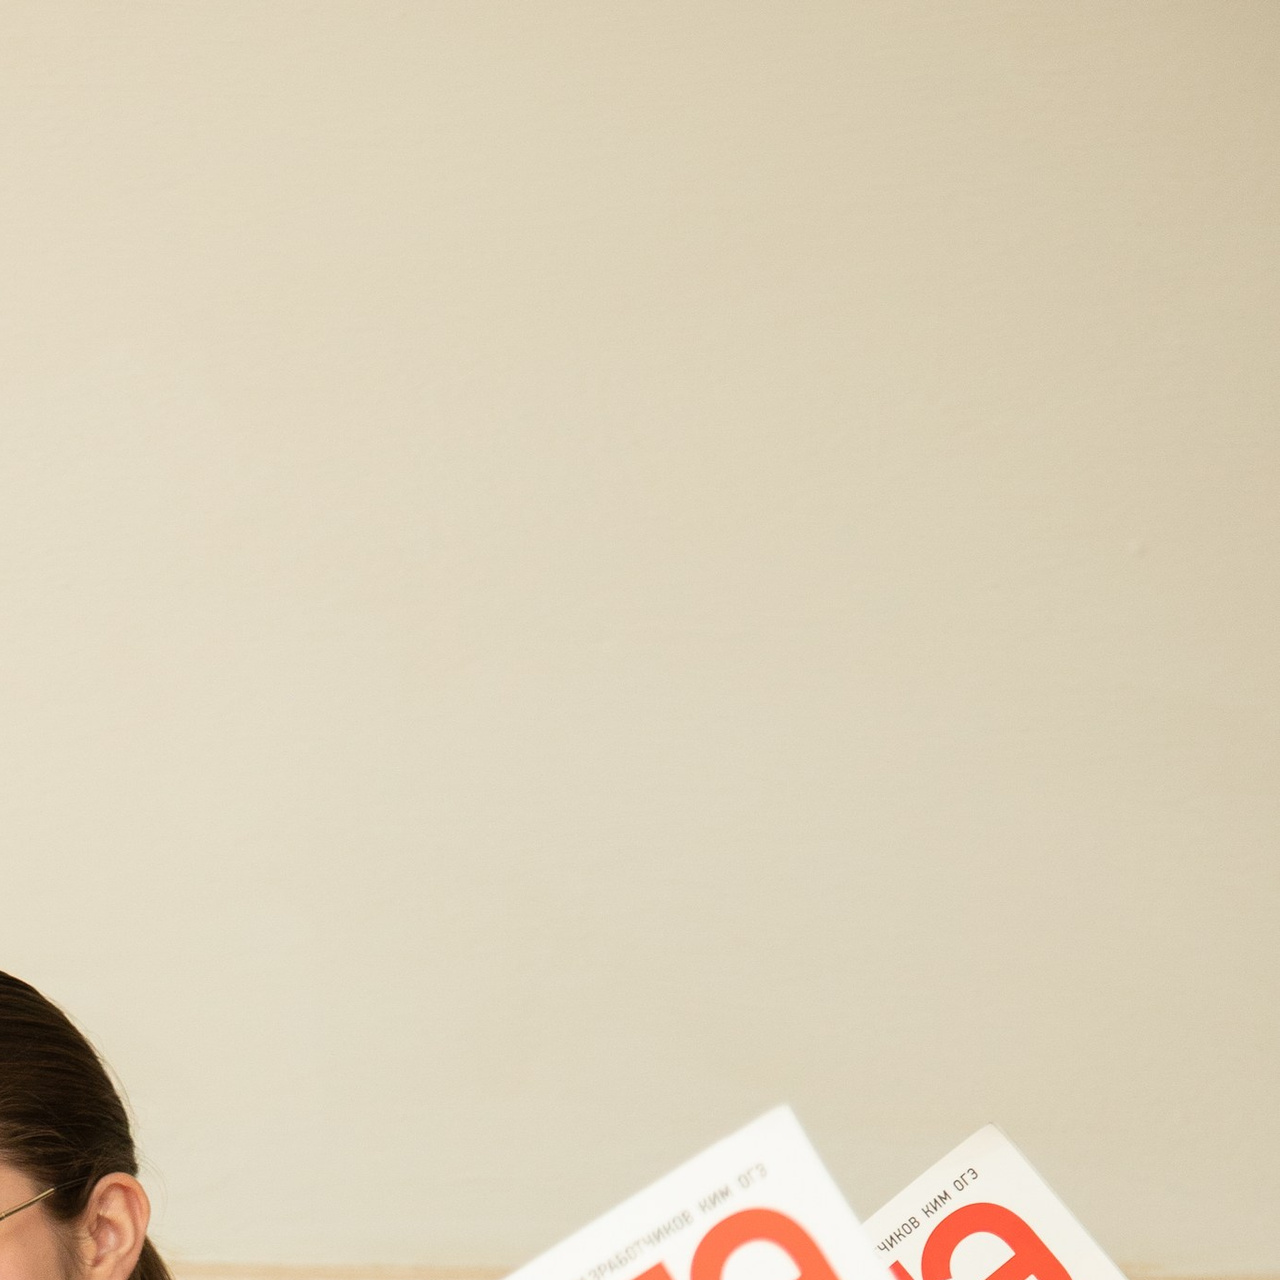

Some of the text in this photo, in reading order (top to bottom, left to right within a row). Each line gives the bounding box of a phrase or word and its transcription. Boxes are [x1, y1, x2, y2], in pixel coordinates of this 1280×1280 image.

[875, 1167, 979, 1252] ЧИКОВ КИМ ОГЭ
